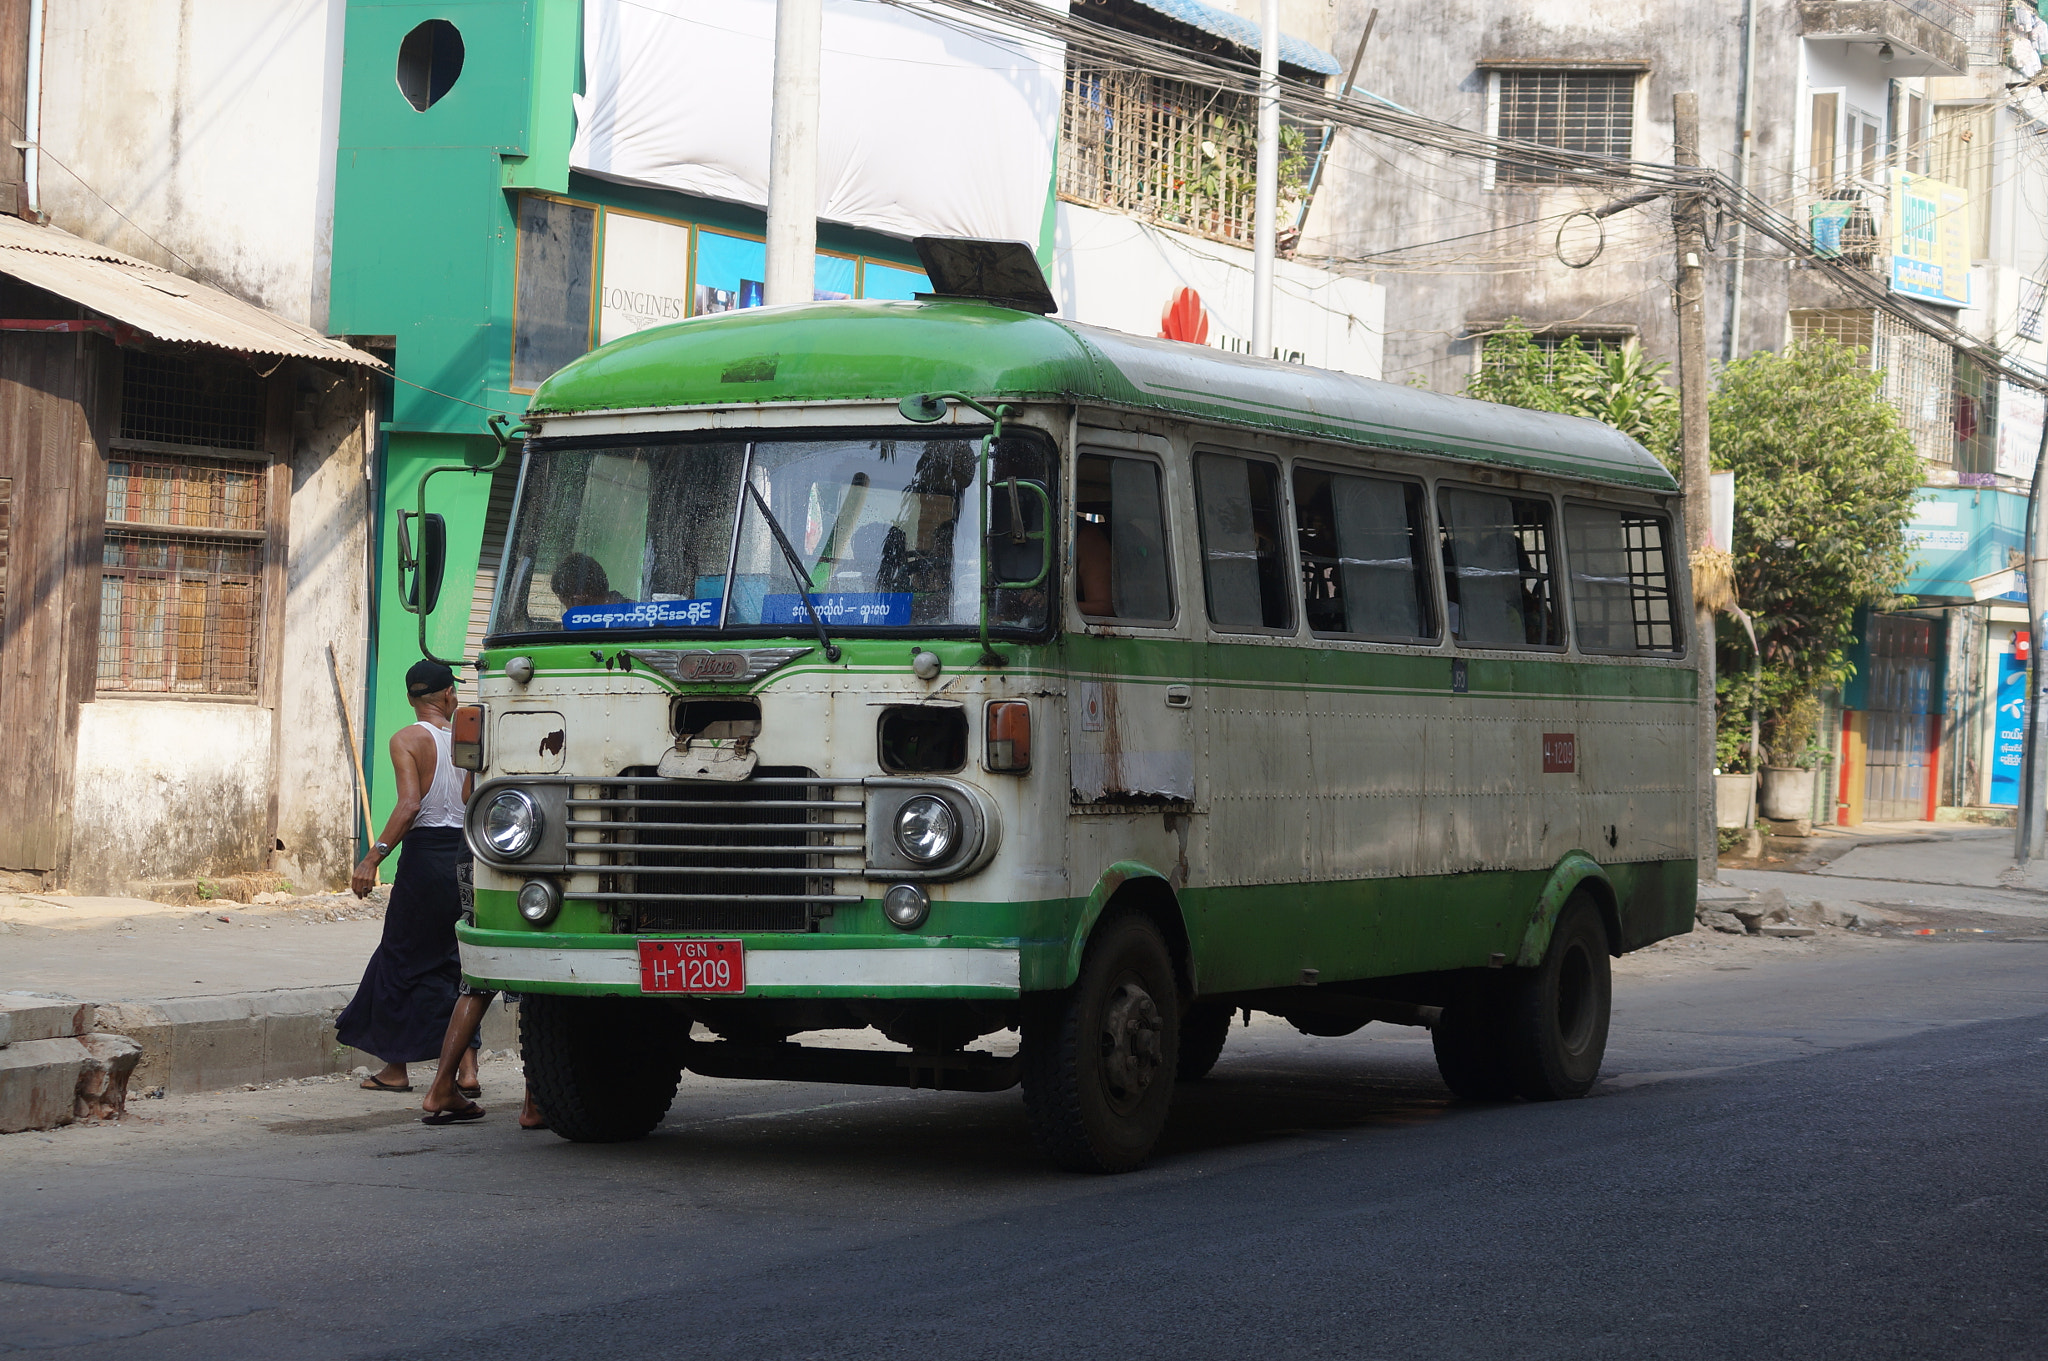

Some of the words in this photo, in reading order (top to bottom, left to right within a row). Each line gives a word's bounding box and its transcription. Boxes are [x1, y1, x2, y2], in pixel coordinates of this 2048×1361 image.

[603, 287, 681, 319] LONGINES
[572, 602, 712, 628] အနောက်ပိုင်းခရိုင်
[689, 655, 735, 678] Hino
[674, 943, 708, 957] YGN
[654, 959, 731, 988] H-1209
